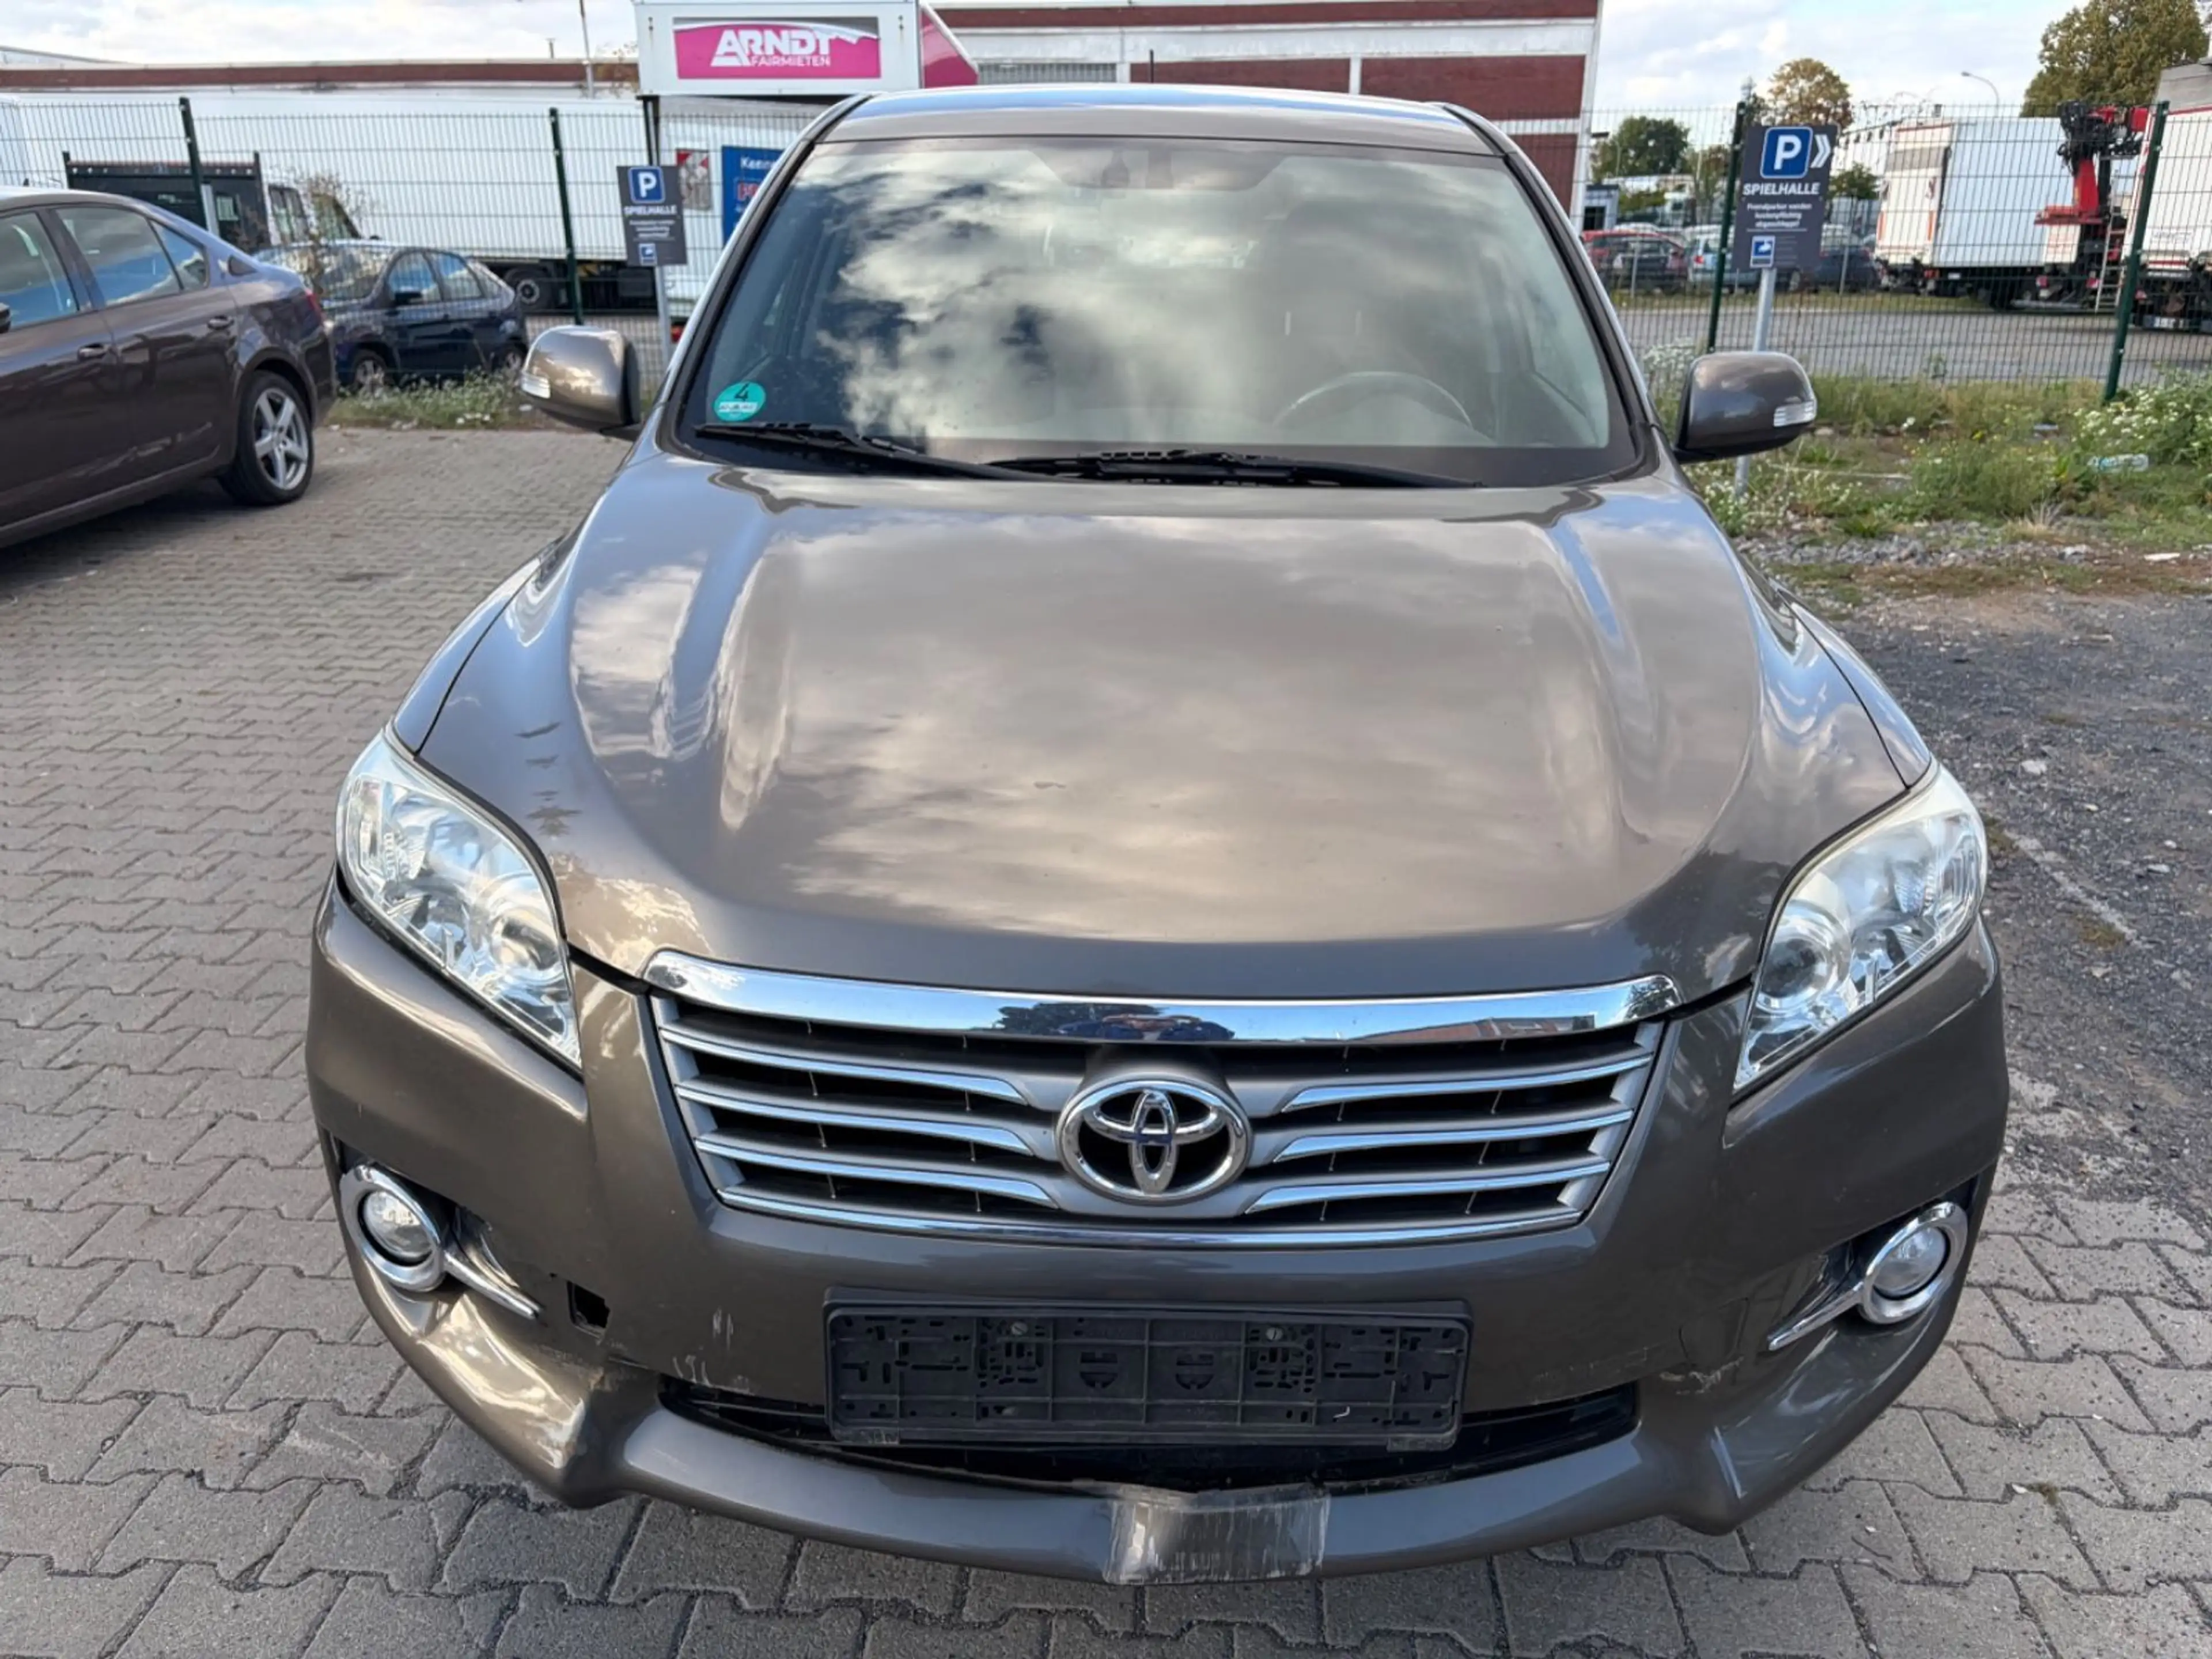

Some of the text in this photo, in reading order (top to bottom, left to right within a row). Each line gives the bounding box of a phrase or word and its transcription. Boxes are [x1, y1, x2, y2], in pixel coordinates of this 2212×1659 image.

[711, 29, 832, 67] ARNDT
[750, 55, 831, 67] FAIRMIETEN
[1774, 134, 1802, 170] P
[638, 172, 657, 198] P
[1743, 183, 1820, 195] SPIELHALLE
[623, 204, 677, 215] SPIELHALLE
[733, 382, 749, 402] 4
